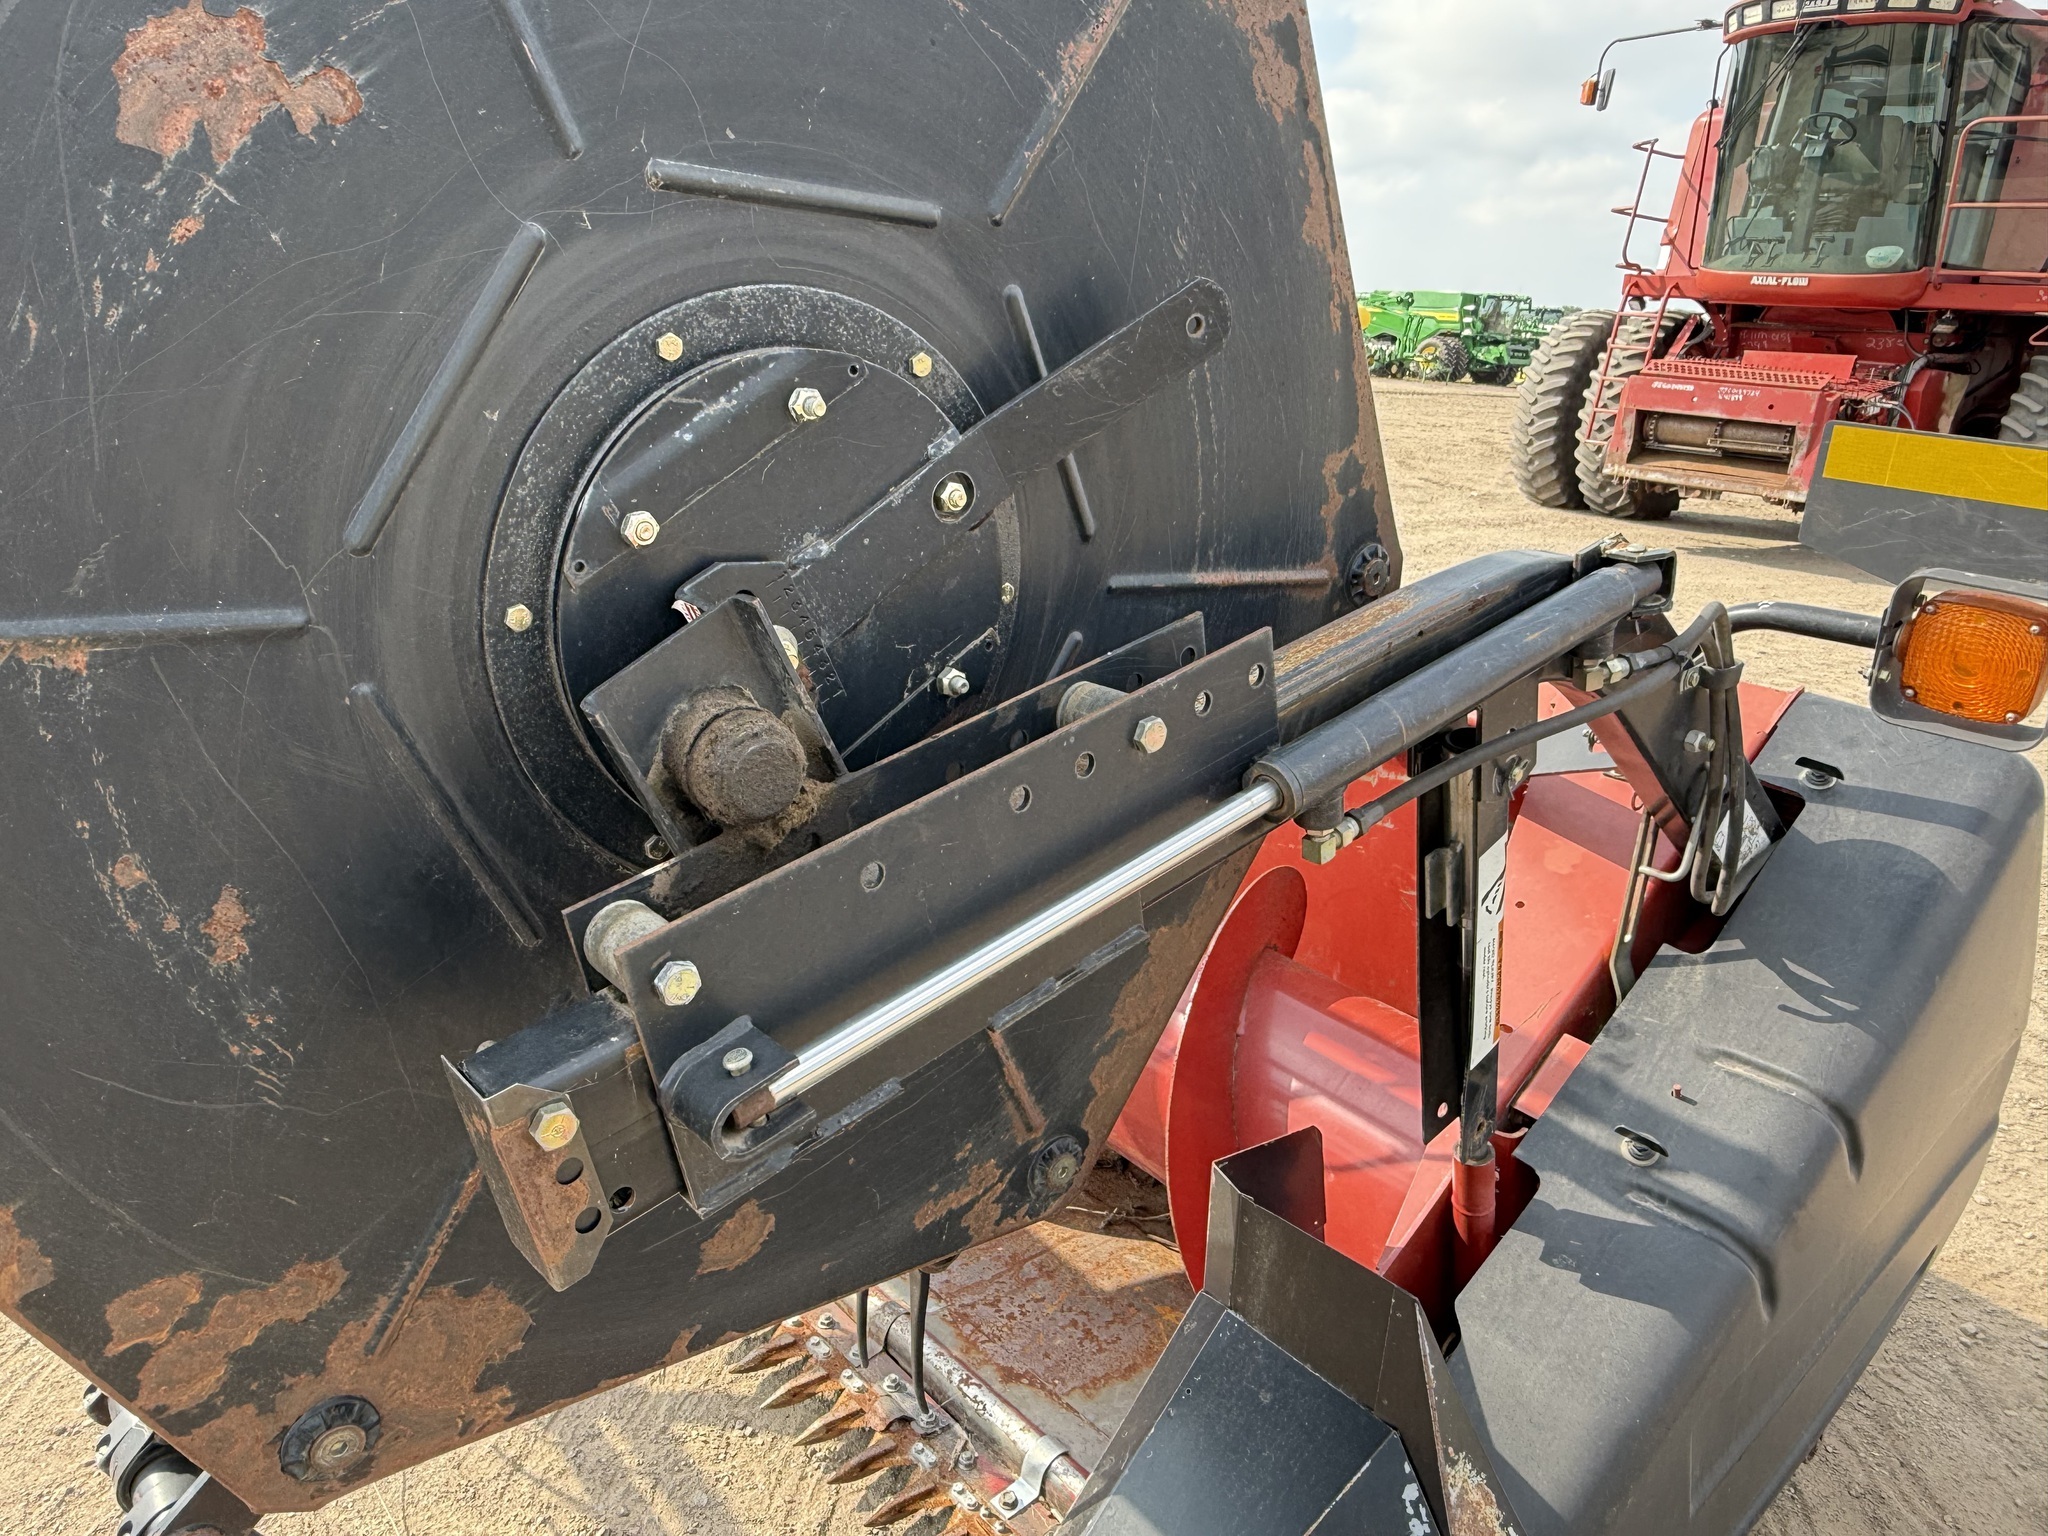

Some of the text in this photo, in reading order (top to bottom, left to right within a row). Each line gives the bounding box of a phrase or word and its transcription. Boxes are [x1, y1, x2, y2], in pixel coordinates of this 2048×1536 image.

[1750, 275, 1809, 286] AXIAL-FLOW
[783, 584, 795, 599] 2
[804, 628, 817, 642] 5
[825, 673, 837, 686] 2
